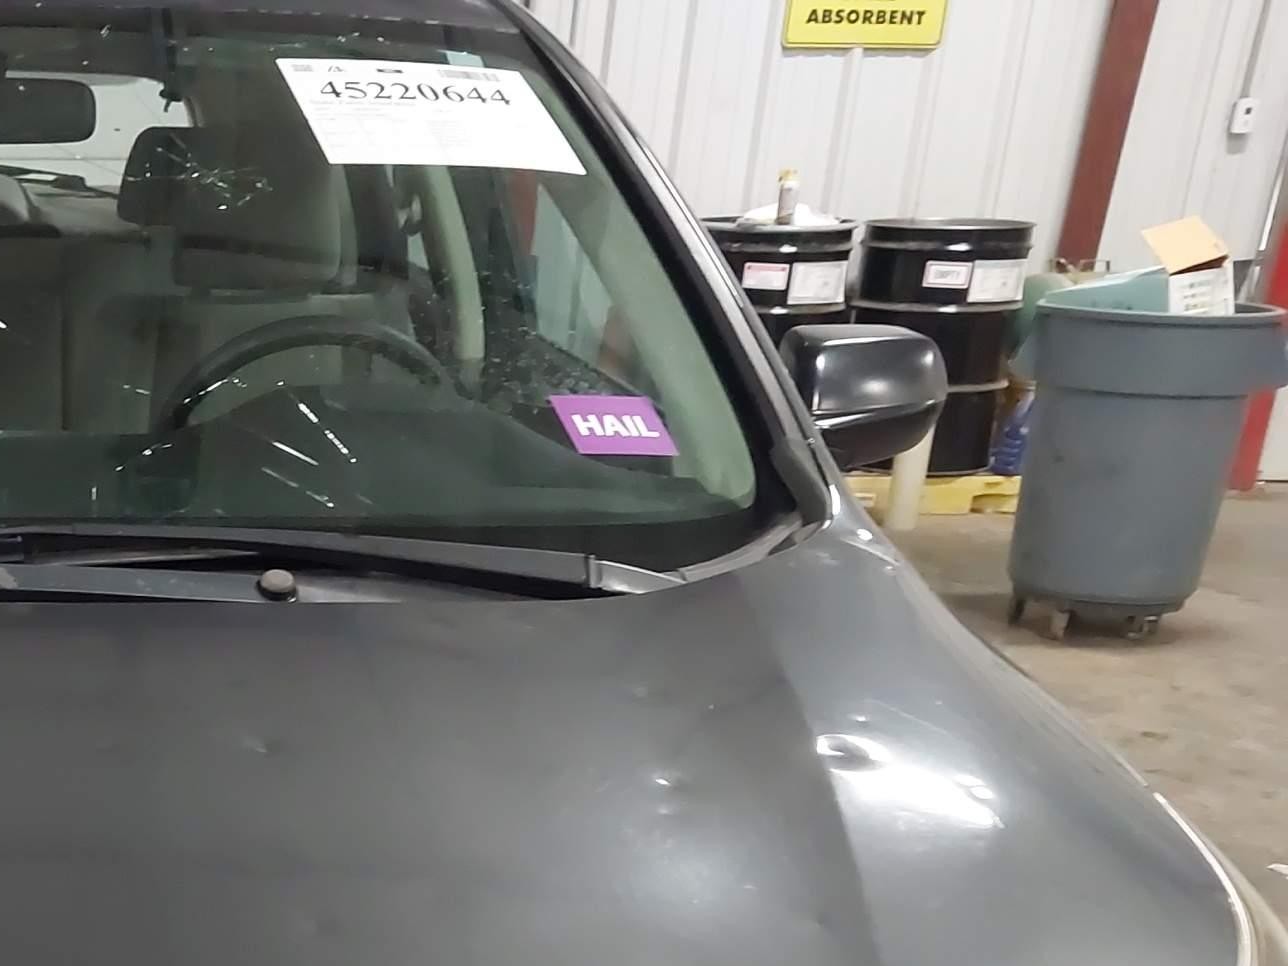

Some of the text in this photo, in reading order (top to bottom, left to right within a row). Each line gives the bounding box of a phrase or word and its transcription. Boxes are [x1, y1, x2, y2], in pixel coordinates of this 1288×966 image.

[805, 8, 926, 25] ABSORBENT
[320, 80, 511, 105] 45220644
[571, 413, 661, 438] HAIL
